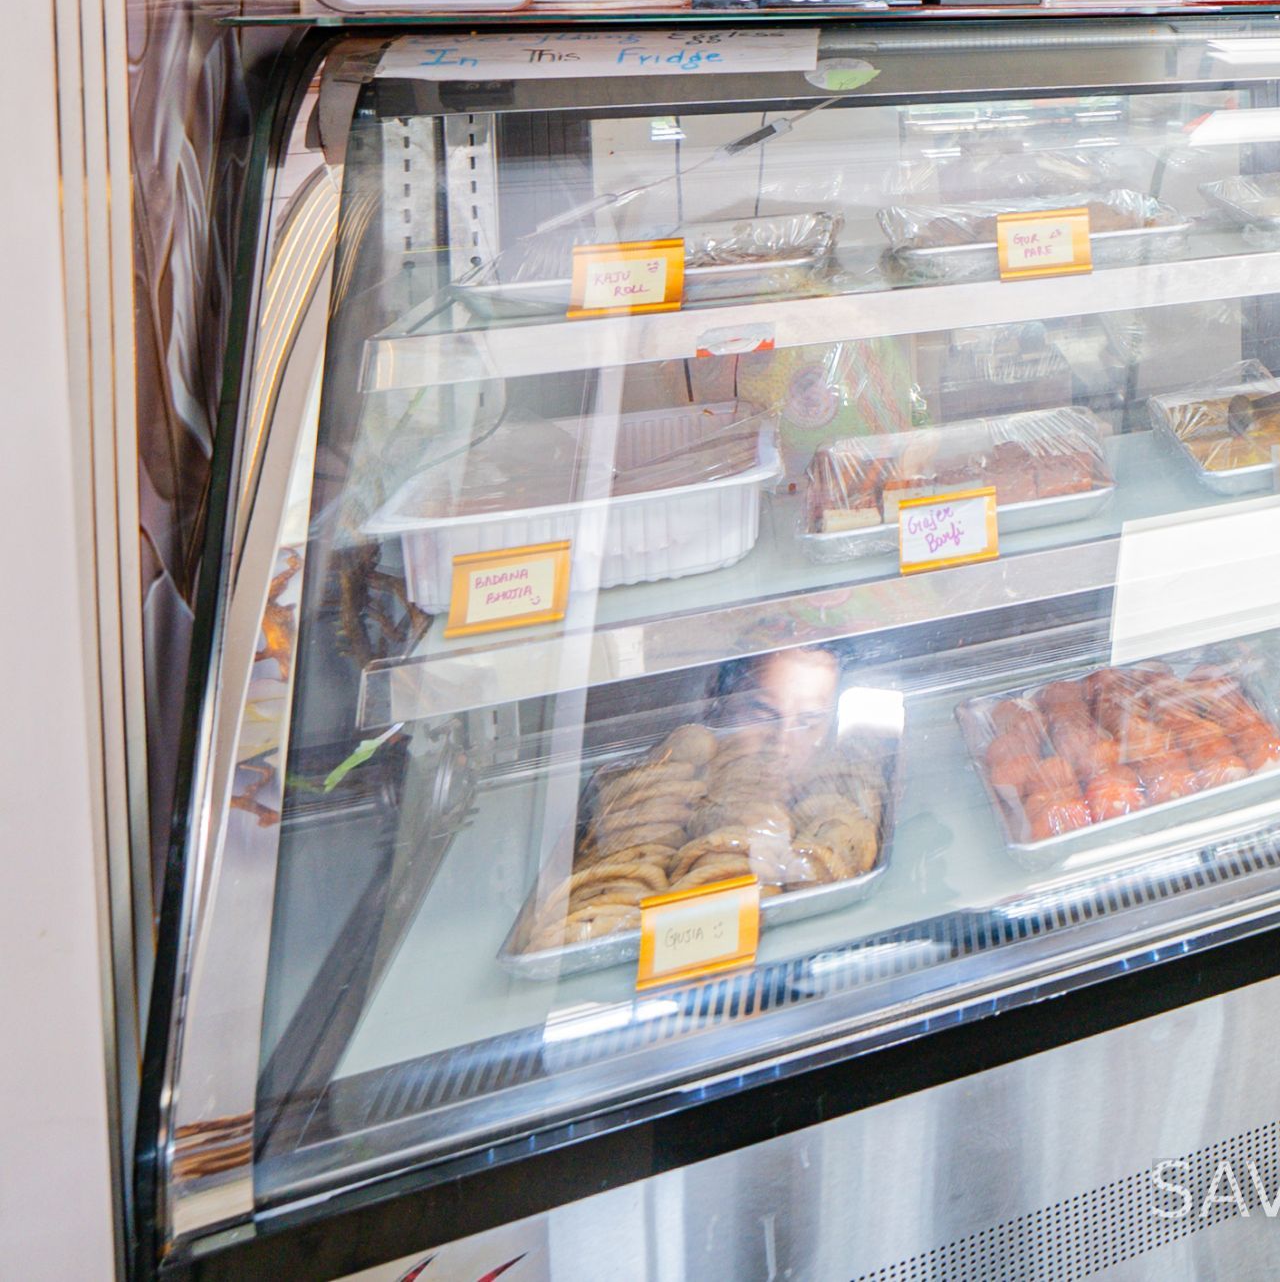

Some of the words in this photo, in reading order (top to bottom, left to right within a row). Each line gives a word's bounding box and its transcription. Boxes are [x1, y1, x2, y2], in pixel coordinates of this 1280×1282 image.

[419, 48, 479, 67] In
[522, 49, 581, 64] This
[616, 46, 724, 70] Fridge
[614, 283, 651, 297] ROLL
